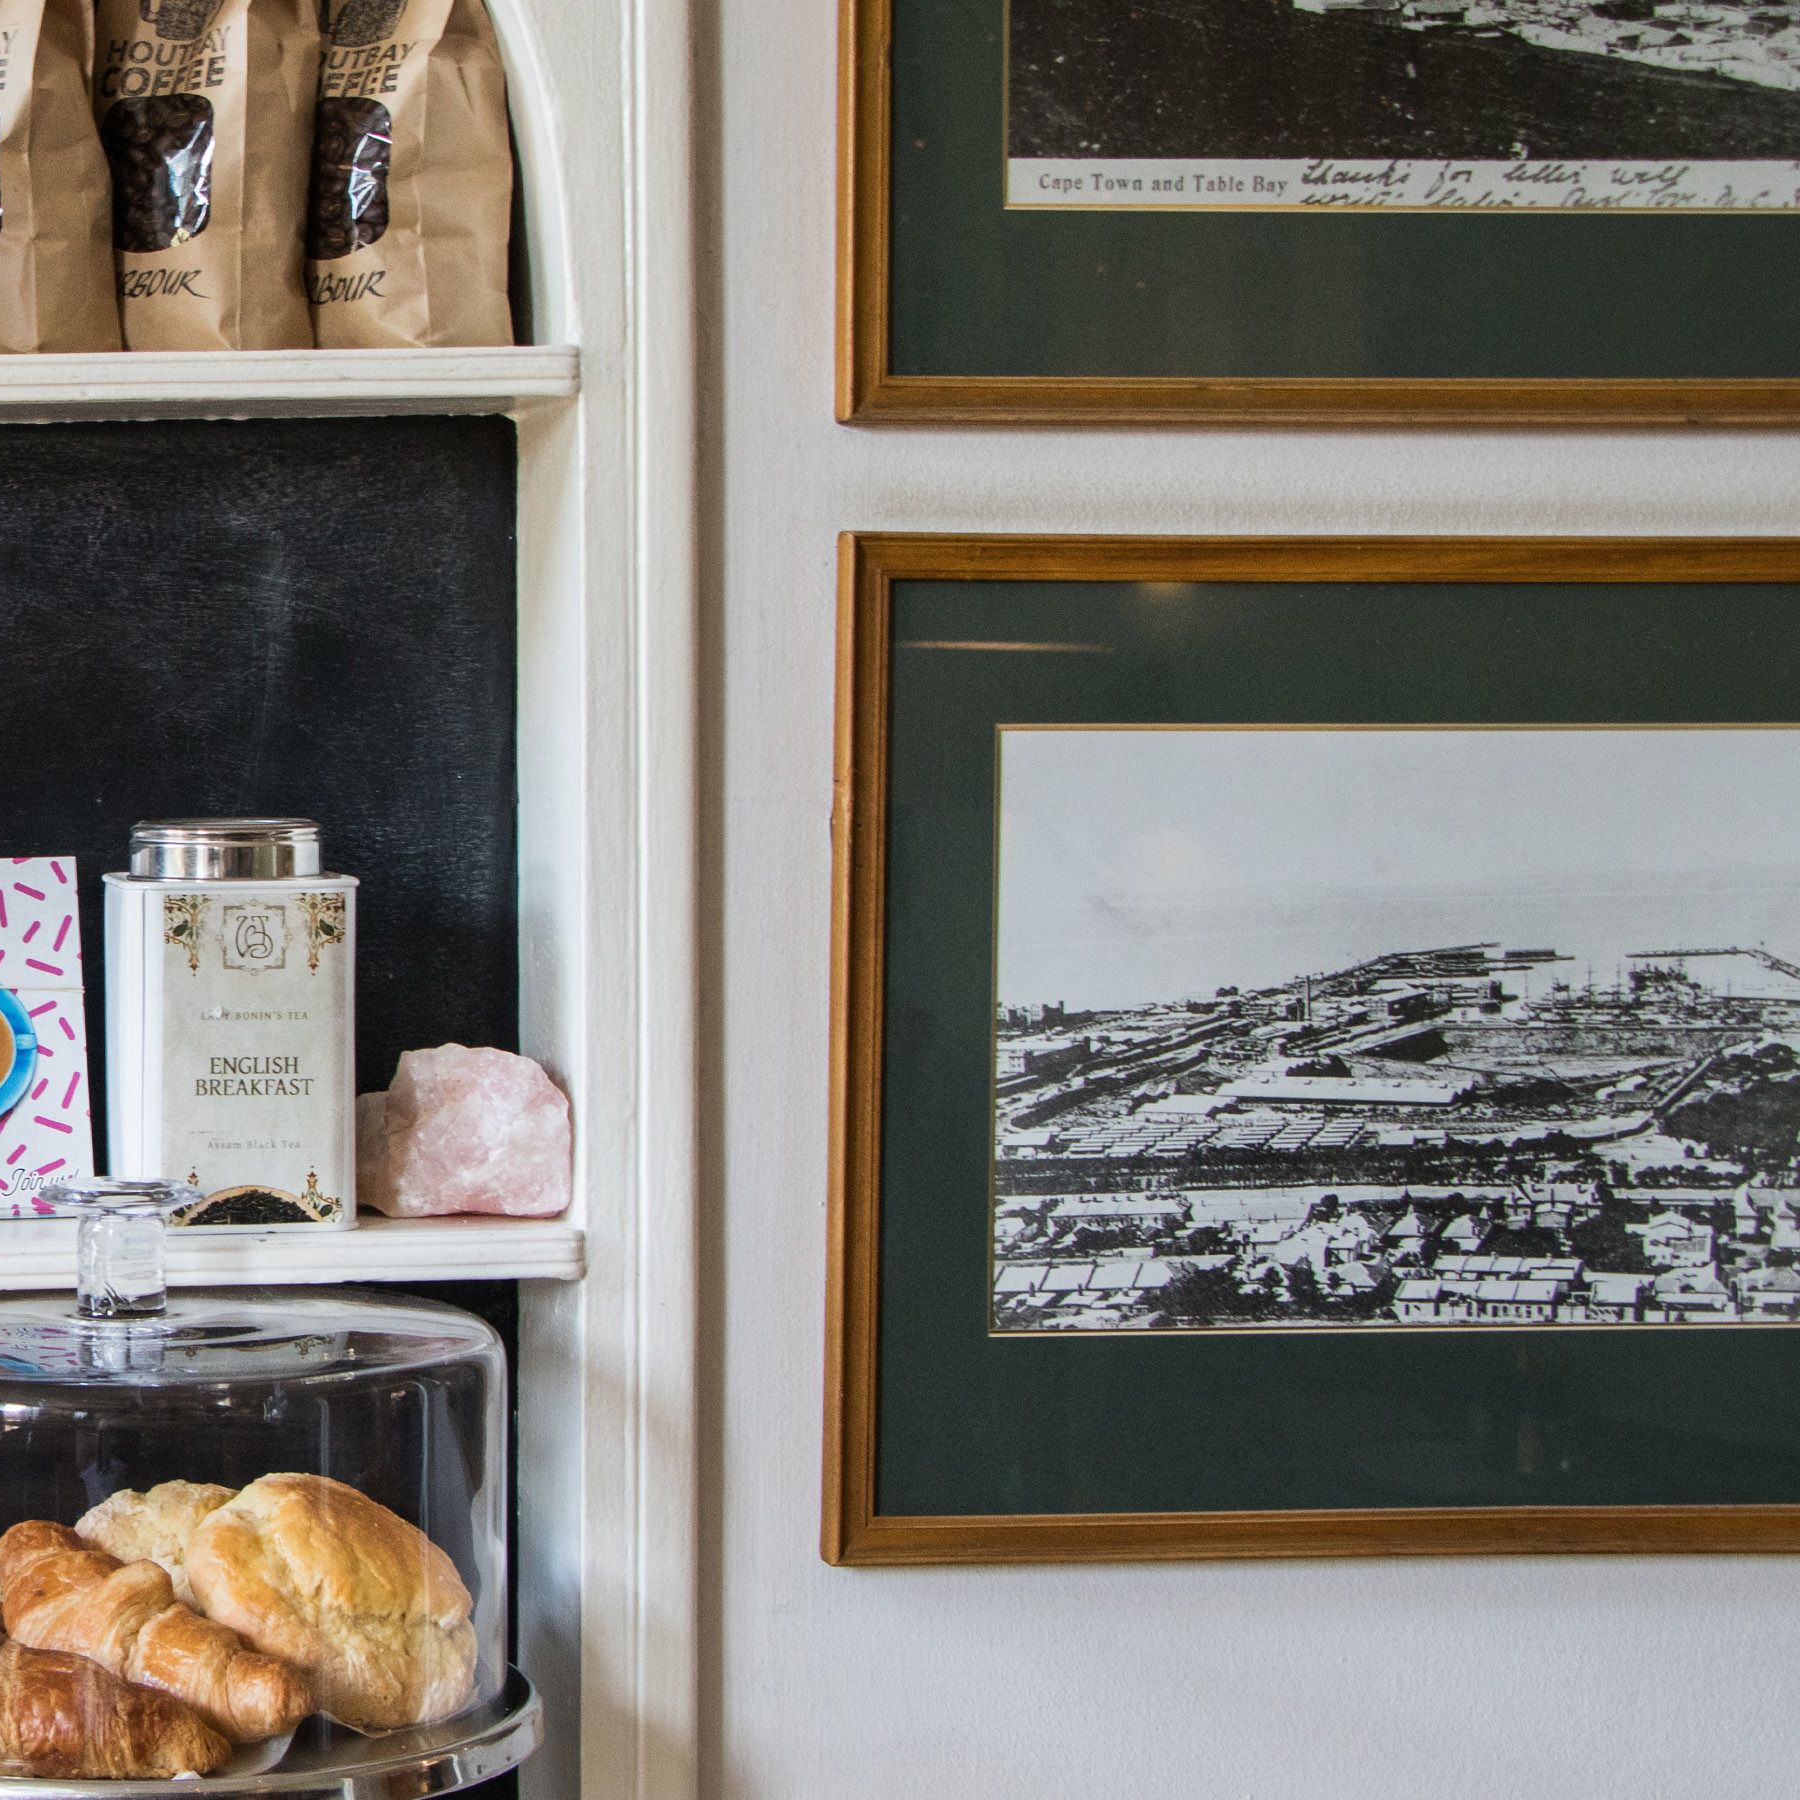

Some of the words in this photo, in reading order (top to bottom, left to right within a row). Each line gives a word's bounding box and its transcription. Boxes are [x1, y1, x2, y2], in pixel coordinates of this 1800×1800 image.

[320, 42, 417, 70] UTBAY
[102, 55, 227, 98] COFFEE
[324, 63, 402, 98] FFEE
[1039, 173, 1084, 193] Cape
[1091, 173, 1143, 192] Town
[1151, 175, 1185, 192] and
[1194, 174, 1245, 193] Table
[1252, 175, 1289, 197] Bay
[1422, 160, 1473, 199] for
[122, 268, 211, 298] RBOUR
[235, 1011, 282, 1020] BONIN'S
[287, 1011, 308, 1020] TEA
[210, 1056, 299, 1074] ENGLISH
[195, 1078, 314, 1096] BREAKFAST
[207, 1140, 242, 1149] Assam
[247, 1139, 277, 1149] Black
[281, 1140, 301, 1149] Tea
[1, 1168, 47, 1197] Join
